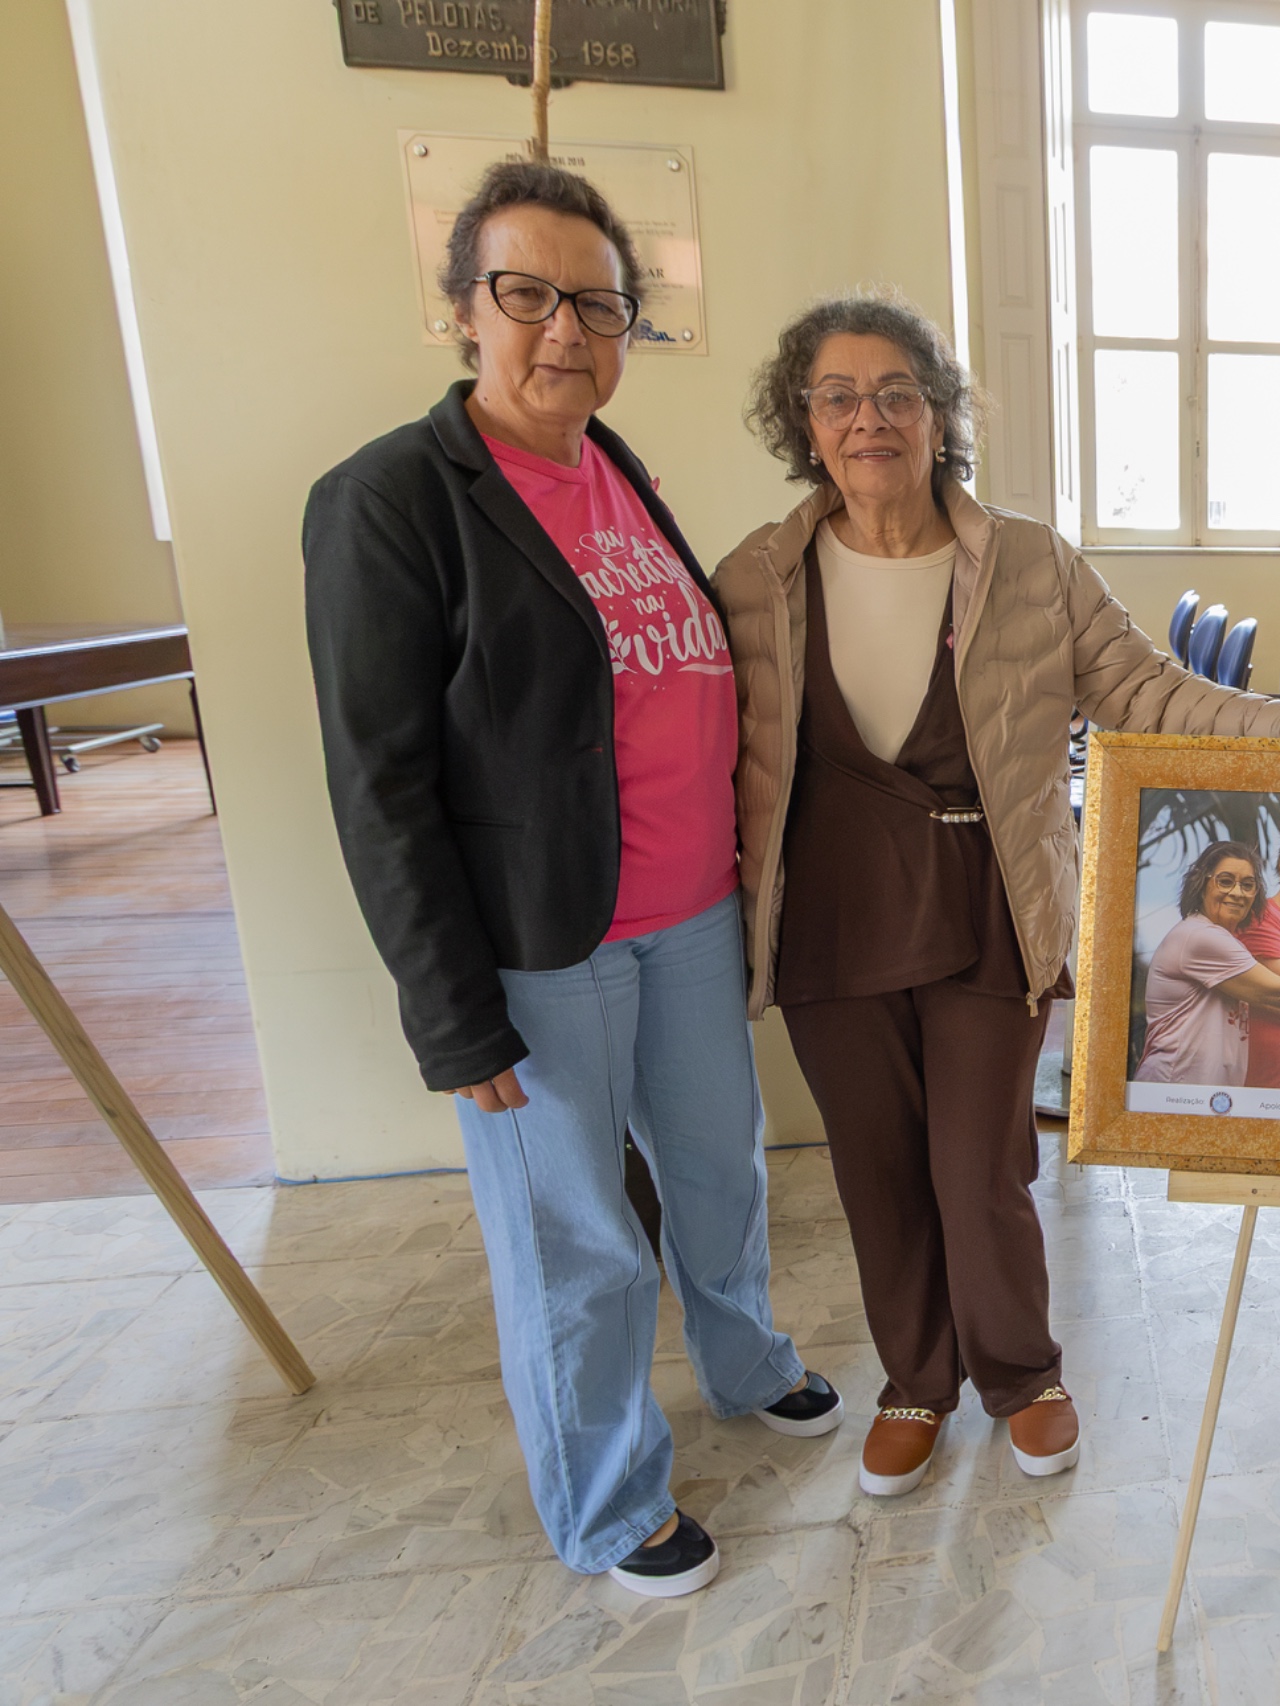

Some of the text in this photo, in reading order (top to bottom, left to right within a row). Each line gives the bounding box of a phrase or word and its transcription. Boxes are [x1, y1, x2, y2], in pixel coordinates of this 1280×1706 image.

[352, 1, 380, 24] DE
[582, 40, 637, 68] 1968
[631, 594, 665, 615] na
[633, 580, 728, 676] vida
